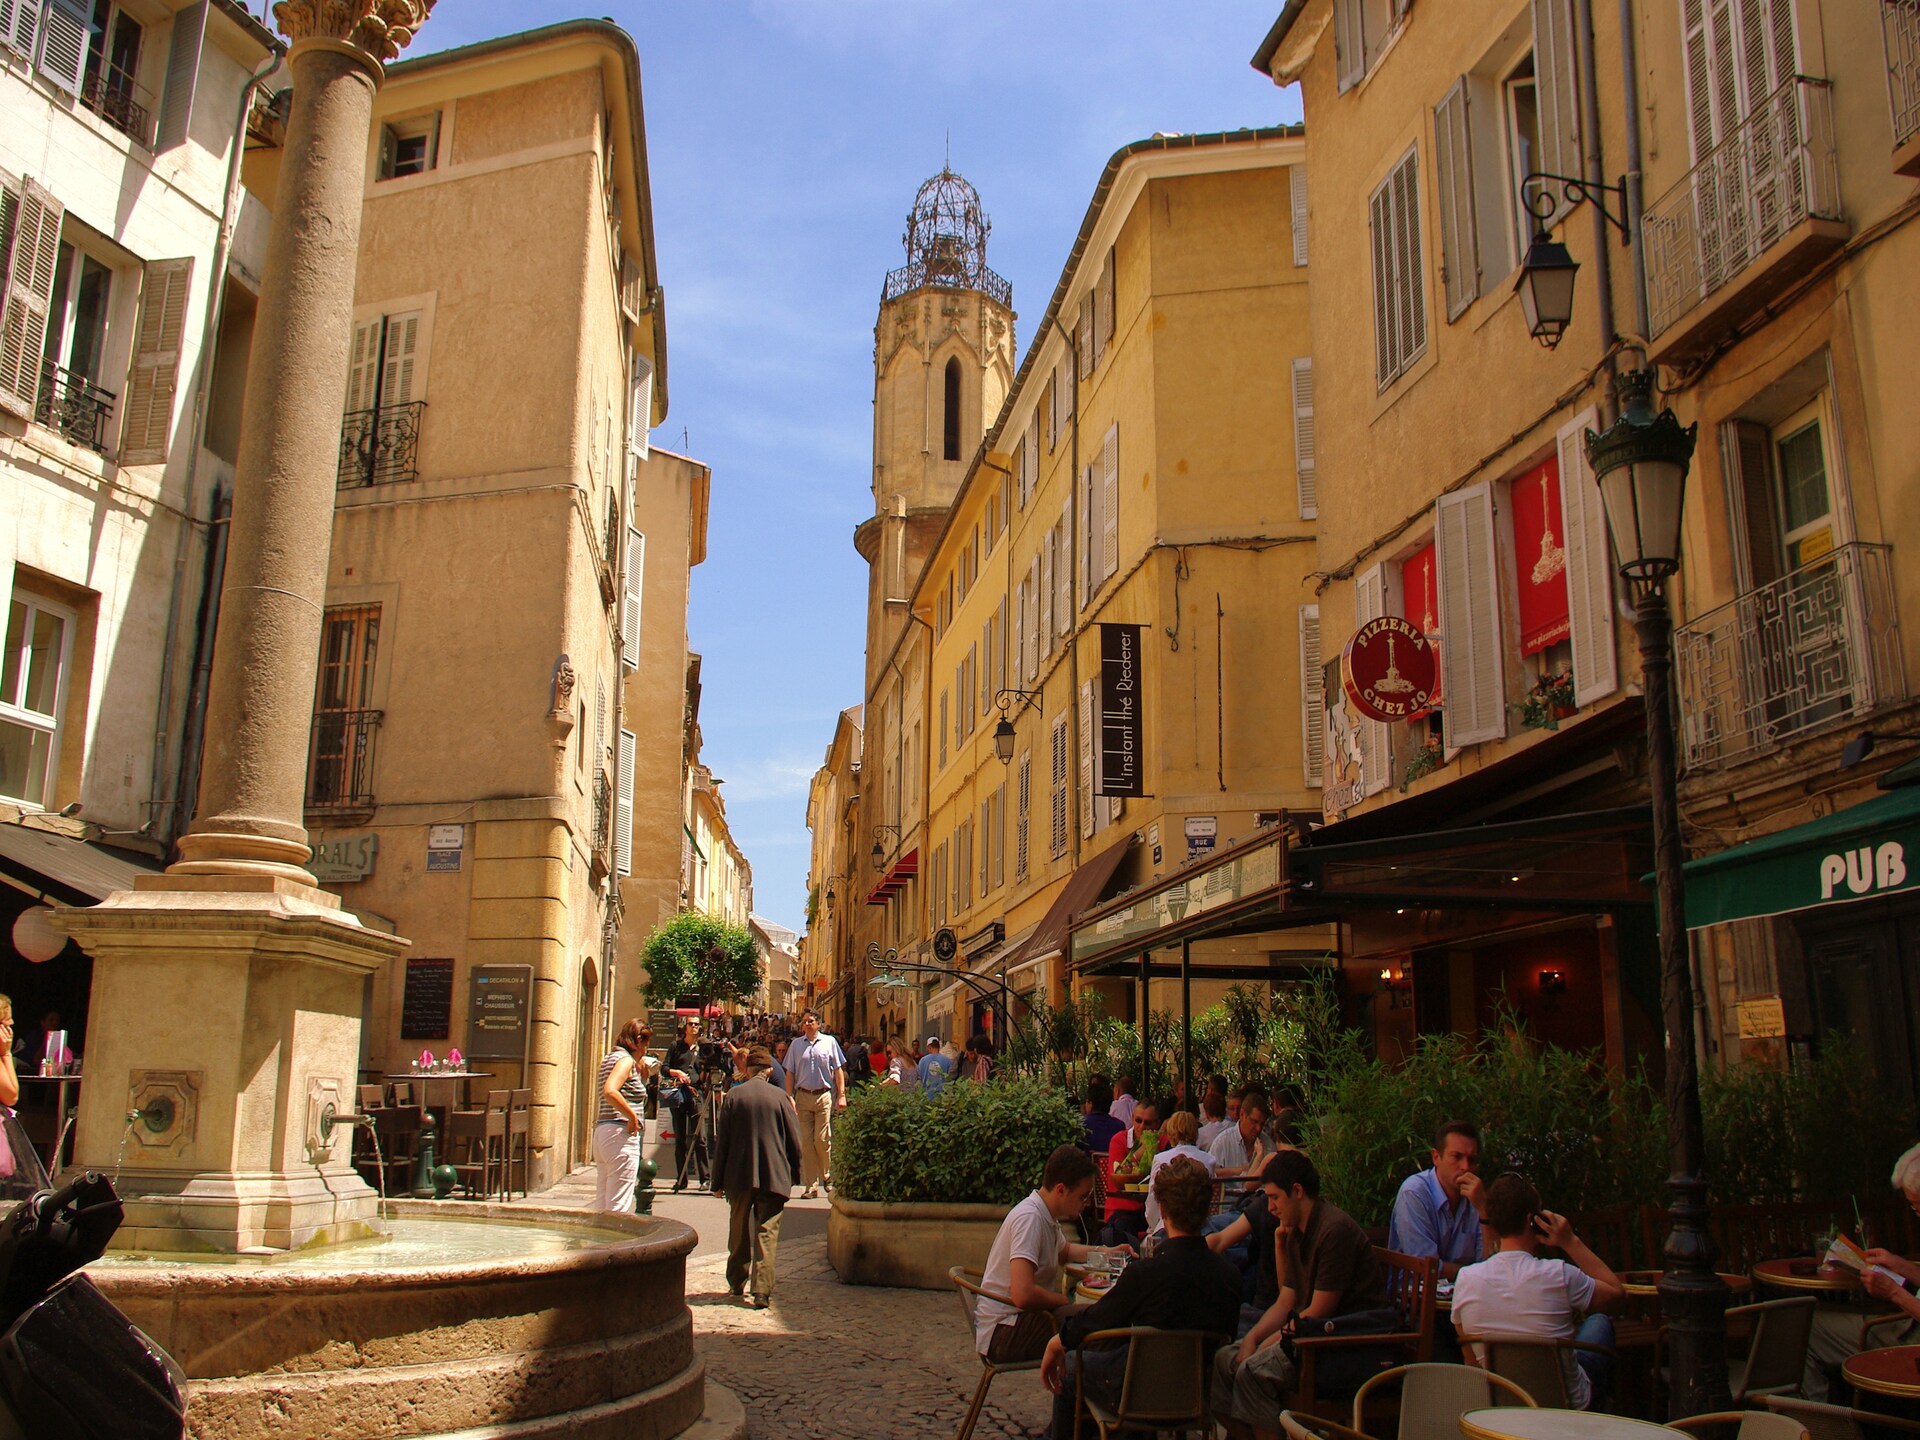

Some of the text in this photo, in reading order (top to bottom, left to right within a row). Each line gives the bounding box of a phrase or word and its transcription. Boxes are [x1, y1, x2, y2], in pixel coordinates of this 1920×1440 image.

[1357, 617, 1426, 652] PIZZERIA
[1103, 632, 1134, 789] L'instant thé Riederer
[1363, 688, 1406, 716] CHEZ
[1411, 690, 1428, 711] JO
[1820, 841, 1906, 899] PUB
